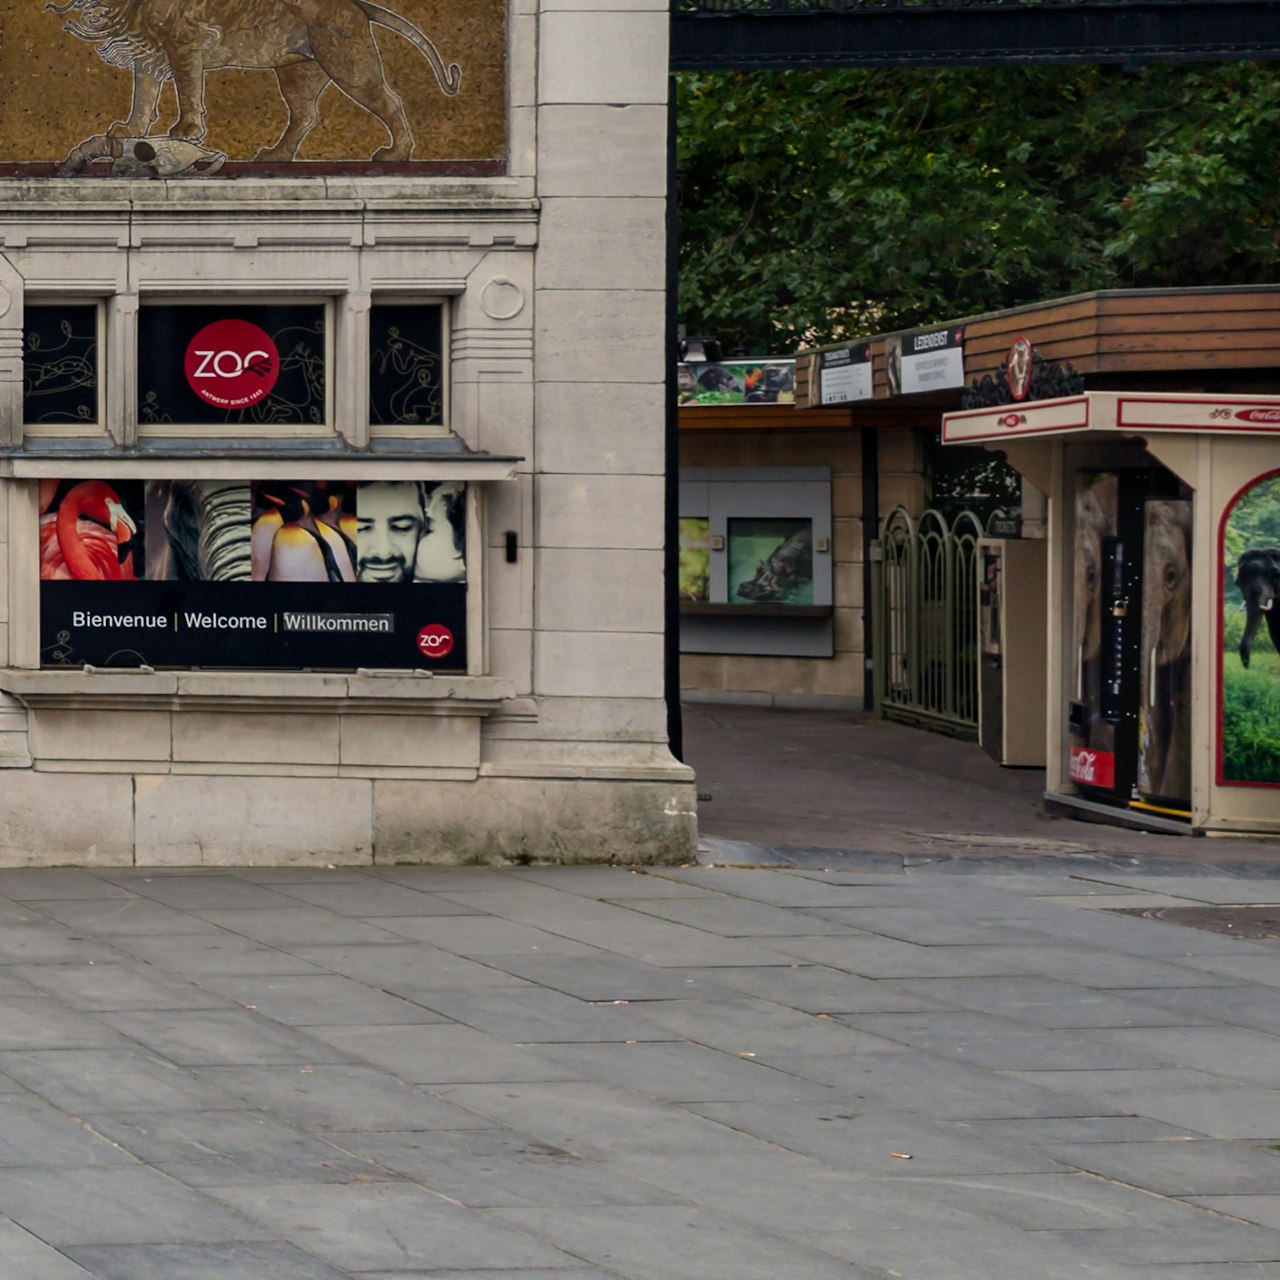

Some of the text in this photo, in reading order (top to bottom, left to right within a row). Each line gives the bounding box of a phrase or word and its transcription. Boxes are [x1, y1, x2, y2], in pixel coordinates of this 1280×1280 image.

[201, 389, 229, 404] ANTWERP
[230, 397, 249, 405] SINCE
[72, 612, 389, 631] Bienvenue Welcome Willkommen
